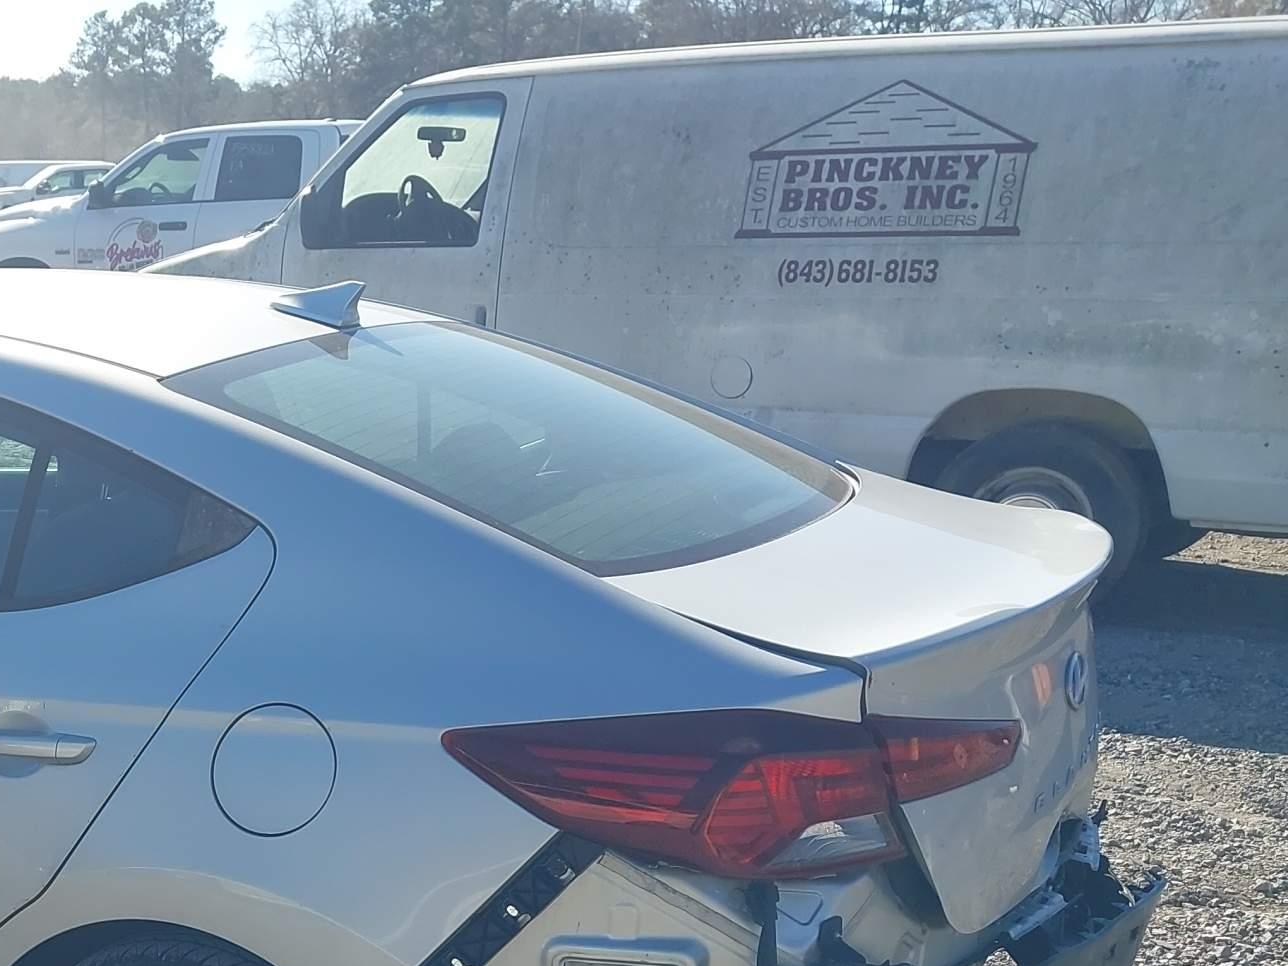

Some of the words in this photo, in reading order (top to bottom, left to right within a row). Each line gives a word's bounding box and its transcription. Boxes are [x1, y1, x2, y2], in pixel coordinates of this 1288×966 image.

[784, 154, 989, 184] PINCKNEY
[779, 186, 887, 212] BROS.
[903, 184, 979, 211] INC.
[994, 156, 1017, 224] 1964
[776, 216, 843, 229] CUSTOM
[846, 215, 893, 228] HOME
[896, 213, 977, 227] BUILDERS
